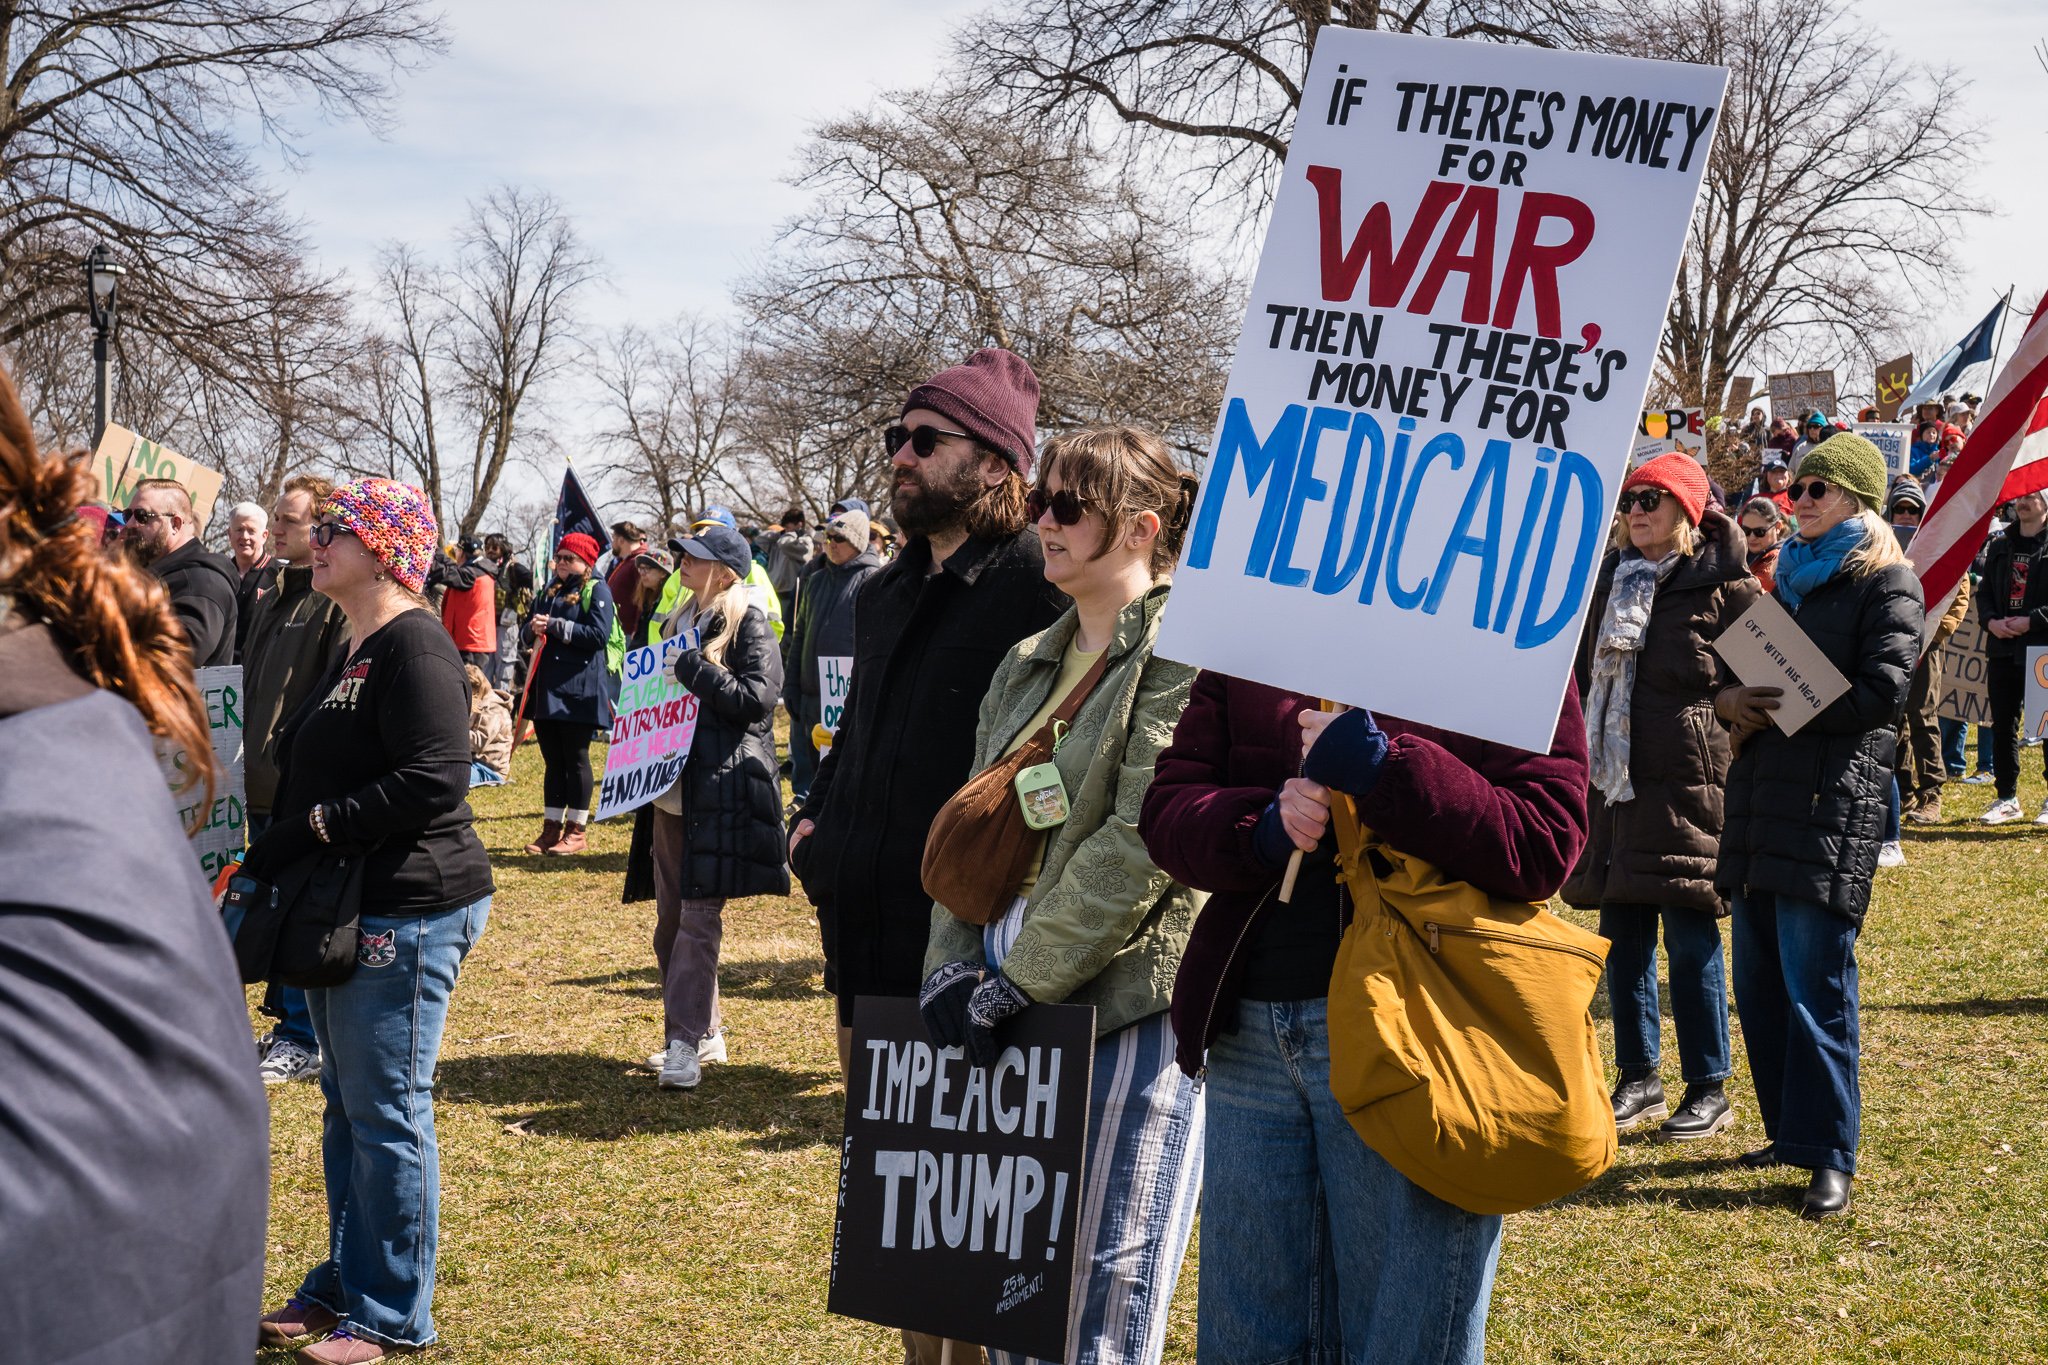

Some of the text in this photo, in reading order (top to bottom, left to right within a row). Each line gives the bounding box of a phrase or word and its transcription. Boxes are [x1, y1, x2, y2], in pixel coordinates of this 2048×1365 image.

[1395, 82, 1565, 150] THERE'S
[1567, 96, 1714, 172] MONEY
[1438, 144, 1528, 187] FOR
[1306, 164, 1602, 355] WAR,
[1266, 304, 1627, 402] THEN THERE'S
[1308, 360, 1571, 450] MONEY FOR
[134, 440, 177, 481] NO
[618, 674, 669, 716] EVEN
[627, 647, 655, 681] SO
[1745, 619, 1822, 709] OFF WITH HIS HEAD
[608, 723, 695, 772] ARE HERE
[611, 693, 698, 746] INTROVERTS
[862, 1039, 1061, 1138] IMPEACH
[838, 1136, 852, 1207] FUCK
[875, 1149, 1069, 1261] TRUMP!
[831, 1220, 843, 1287] ICE!
[1002, 1272, 1026, 1297] 25th
[995, 1271, 1044, 1315] AMENDMENT!
